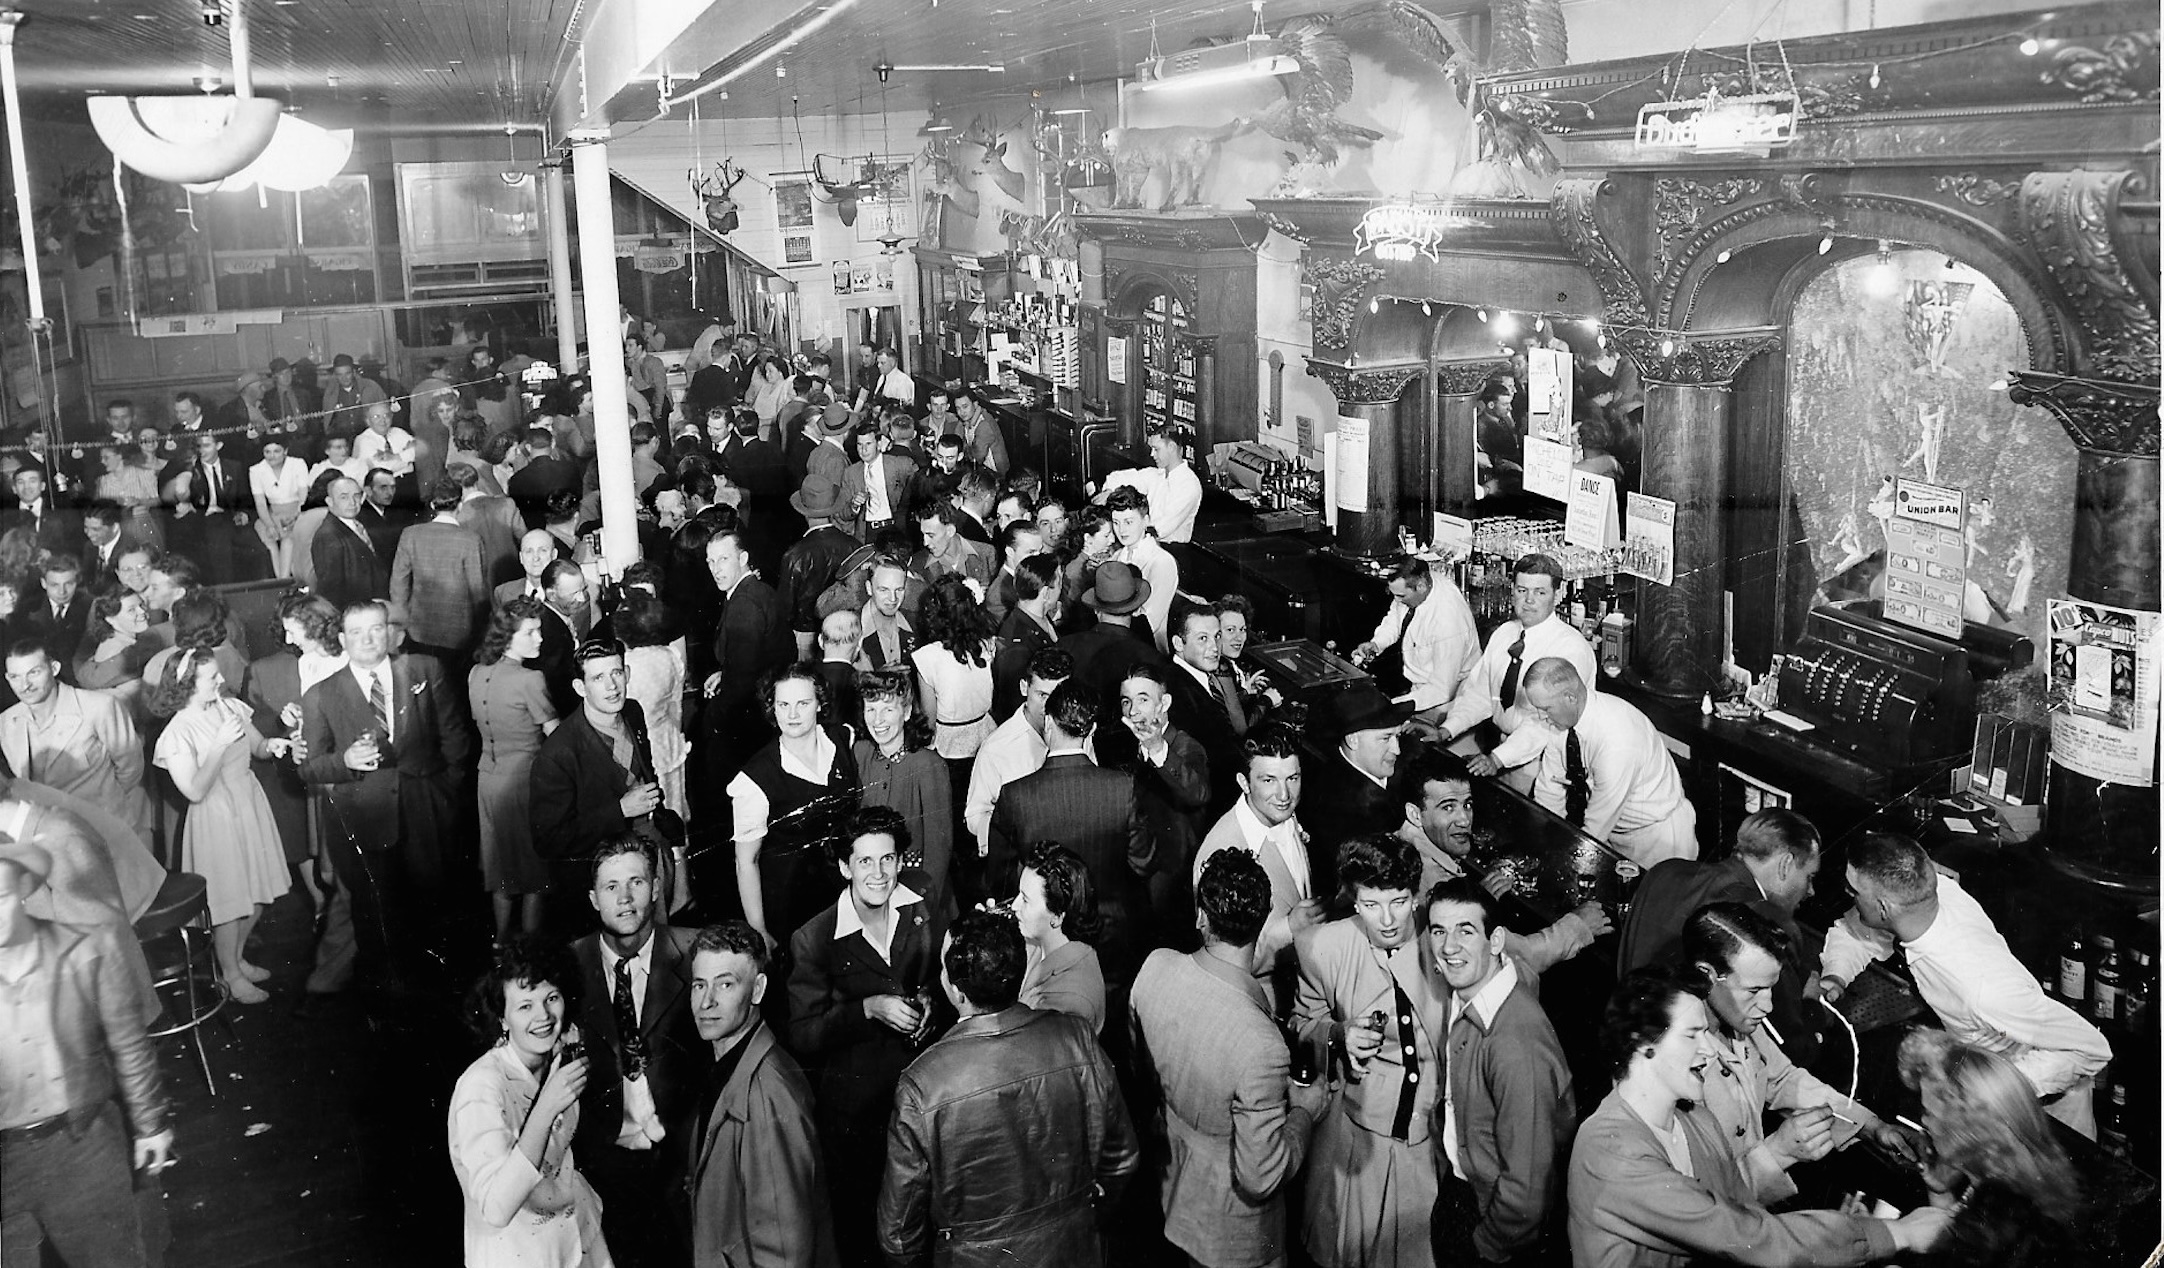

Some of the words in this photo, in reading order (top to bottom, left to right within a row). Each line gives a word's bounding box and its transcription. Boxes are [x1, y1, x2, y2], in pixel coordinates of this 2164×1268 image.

[1580, 477, 1601, 496] DANCE
[1907, 504, 1936, 514] UNION
[1938, 505, 1959, 515] BAR
